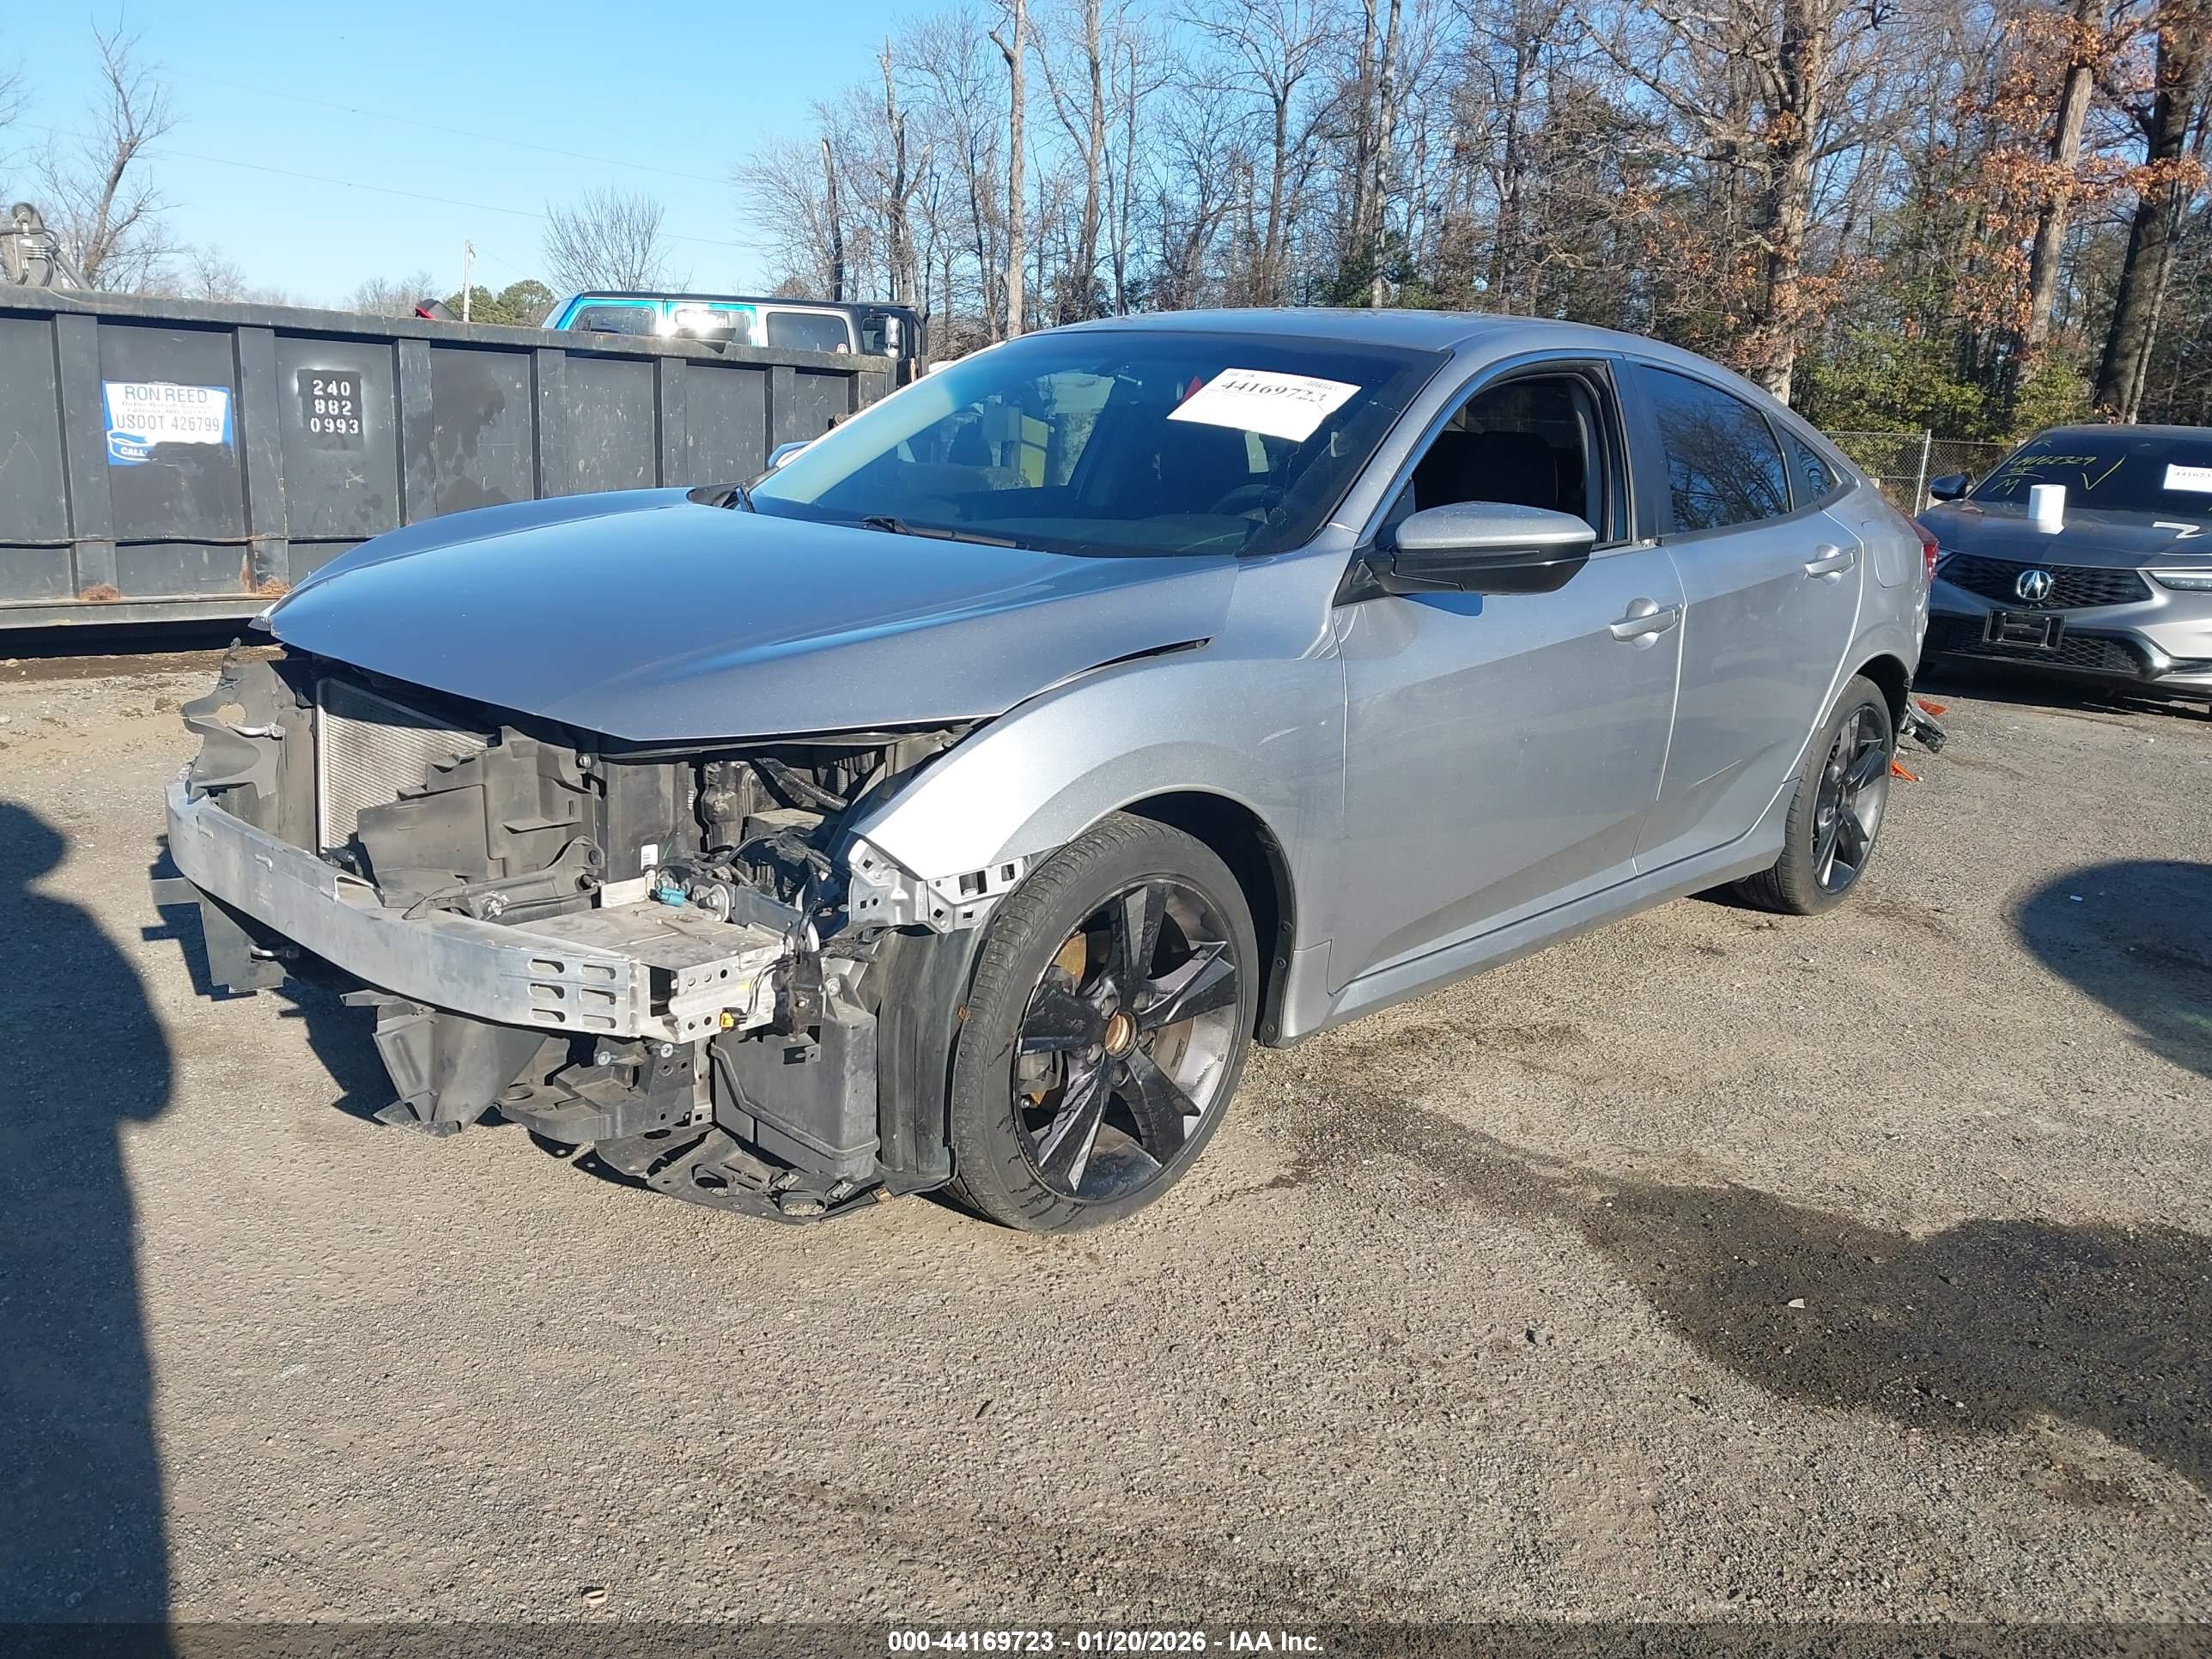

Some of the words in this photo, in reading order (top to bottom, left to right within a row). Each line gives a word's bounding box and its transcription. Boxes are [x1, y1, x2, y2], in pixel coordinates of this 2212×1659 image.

[124, 386, 161, 401] RON
[165, 388, 208, 404] REED
[312, 380, 351, 396] 240
[1221, 380, 1327, 403] 44169723
[313, 399, 353, 416] 882
[116, 414, 165, 430] USDOT
[171, 416, 220, 432] 426799
[310, 418, 360, 434] 0993
